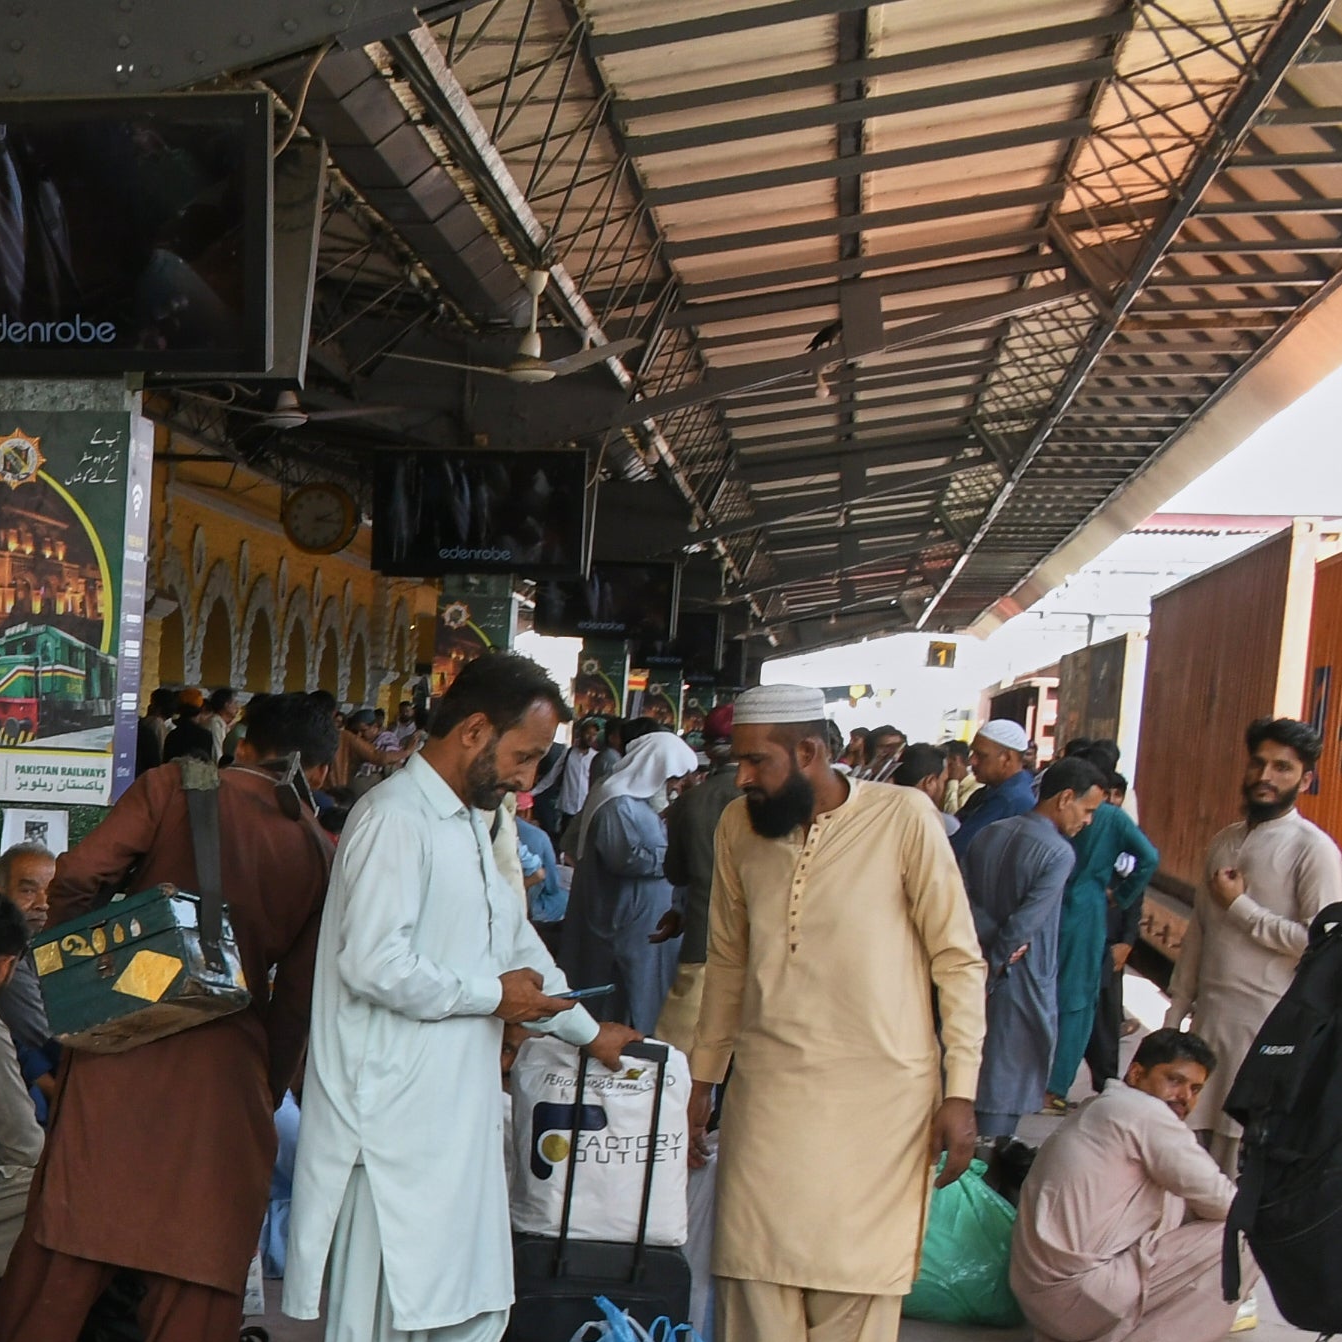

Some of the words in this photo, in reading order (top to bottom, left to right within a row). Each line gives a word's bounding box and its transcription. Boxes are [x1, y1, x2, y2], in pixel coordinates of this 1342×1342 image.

[105, 431, 122, 448] آپ
[77, 451, 93, 467] سفر
[100, 450, 120, 468] آرام
[439, 546, 512, 560] edenrobe
[937, 649, 947, 666] 1
[15, 765, 60, 776] PAKISTAN
[60, 766, 107, 778] RAILWAYS
[16, 777, 54, 792] ریلویز
[56, 779, 104, 795] پاکستان
[576, 1132, 683, 1149] FACTORY
